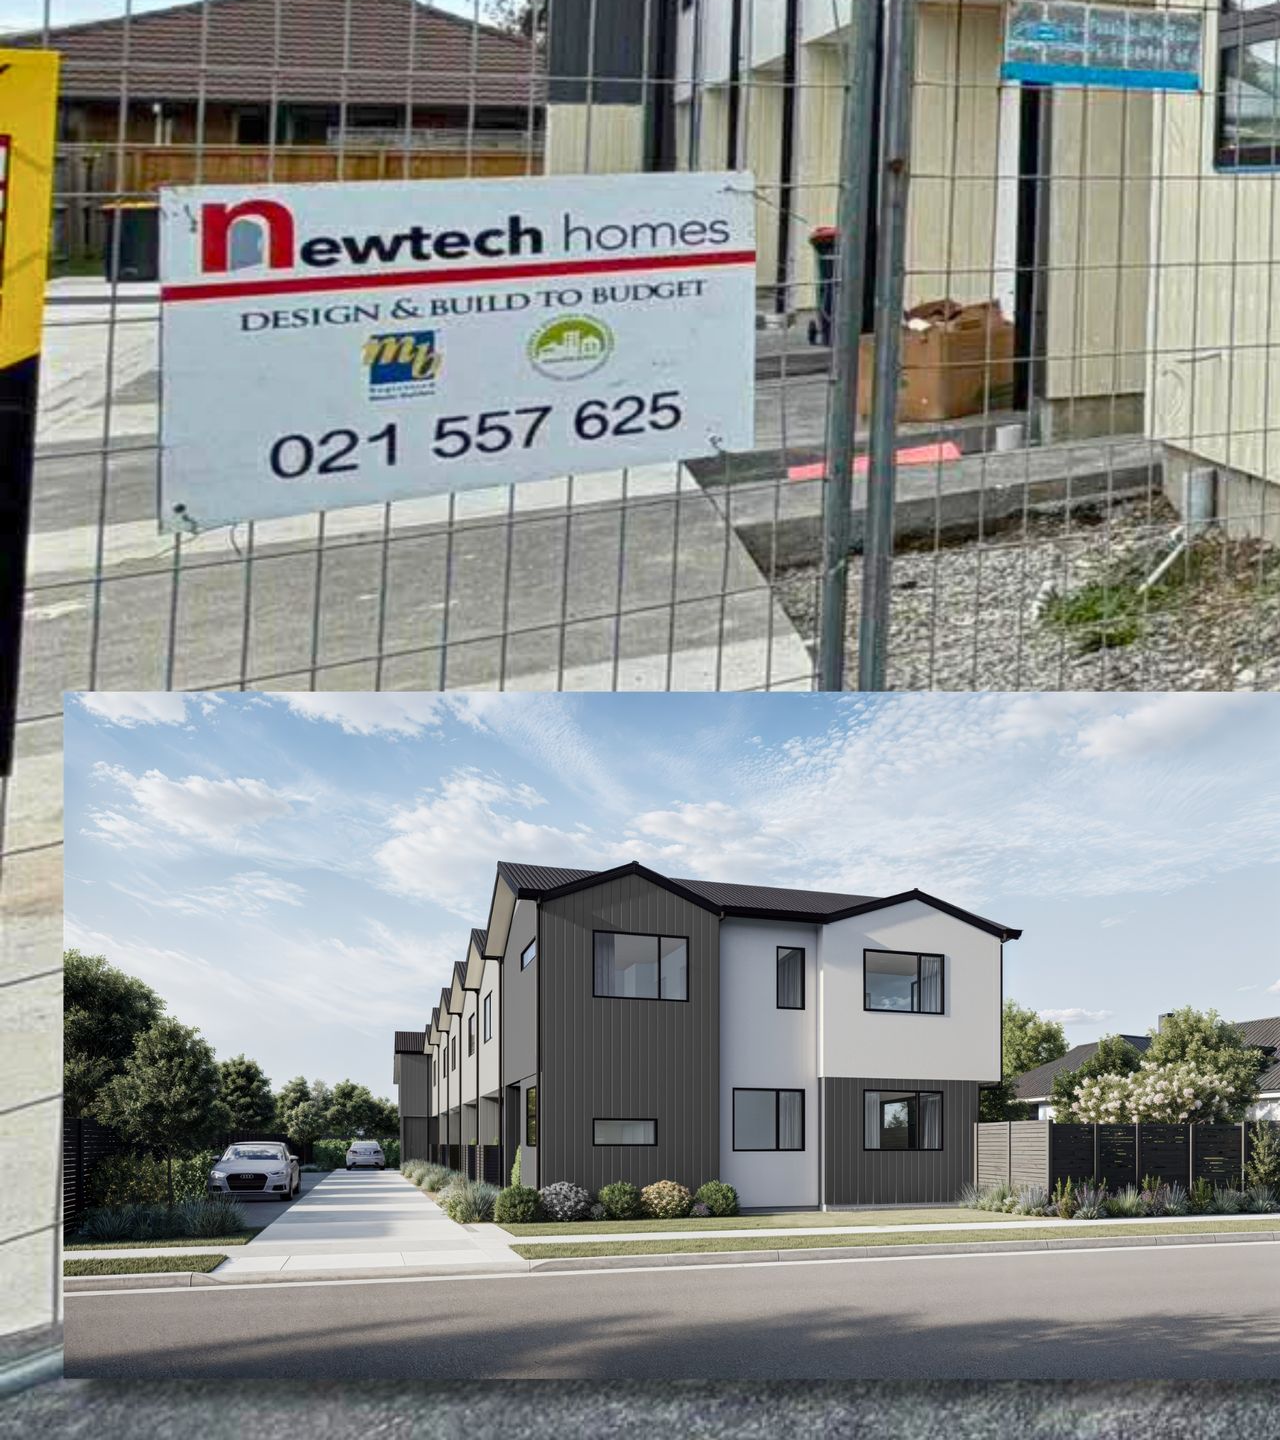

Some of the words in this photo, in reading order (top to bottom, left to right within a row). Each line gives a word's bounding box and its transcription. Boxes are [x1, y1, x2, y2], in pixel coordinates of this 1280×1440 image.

[564, 212, 730, 252] homes
[240, 303, 380, 332] DESIGN
[390, 297, 419, 320] &
[430, 292, 532, 317] BUILD
[536, 289, 583, 307] TO
[592, 279, 708, 305] BUDGET
[270, 423, 397, 479] 021
[432, 406, 553, 458] 557
[574, 391, 682, 440] 625
